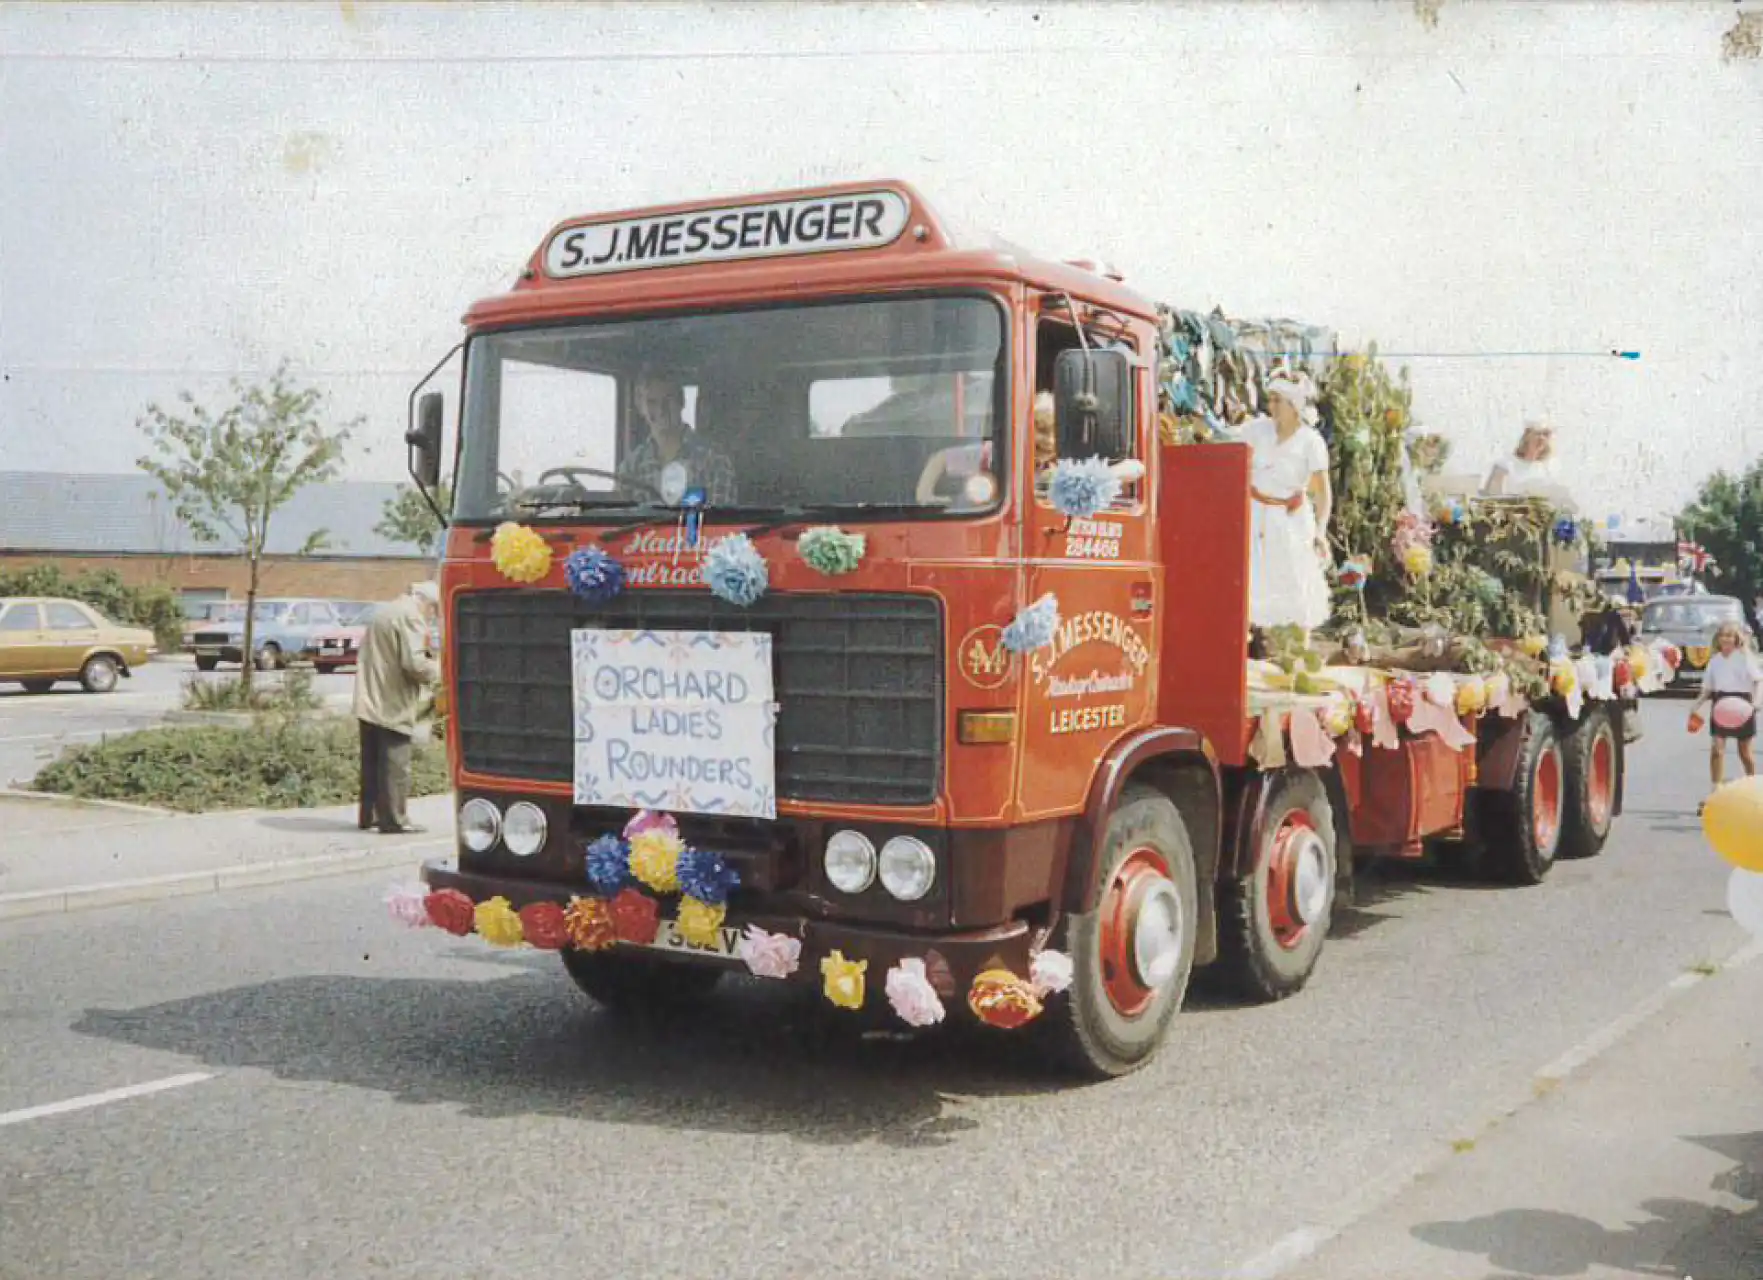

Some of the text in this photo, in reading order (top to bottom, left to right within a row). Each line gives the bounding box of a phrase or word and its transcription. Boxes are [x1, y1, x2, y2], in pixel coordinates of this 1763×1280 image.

[594, 664, 748, 704] ORCHARD
[631, 708, 723, 741] LADIES
[1051, 704, 1126, 734] LEICESTER
[605, 738, 753, 791] ROUNDERS
